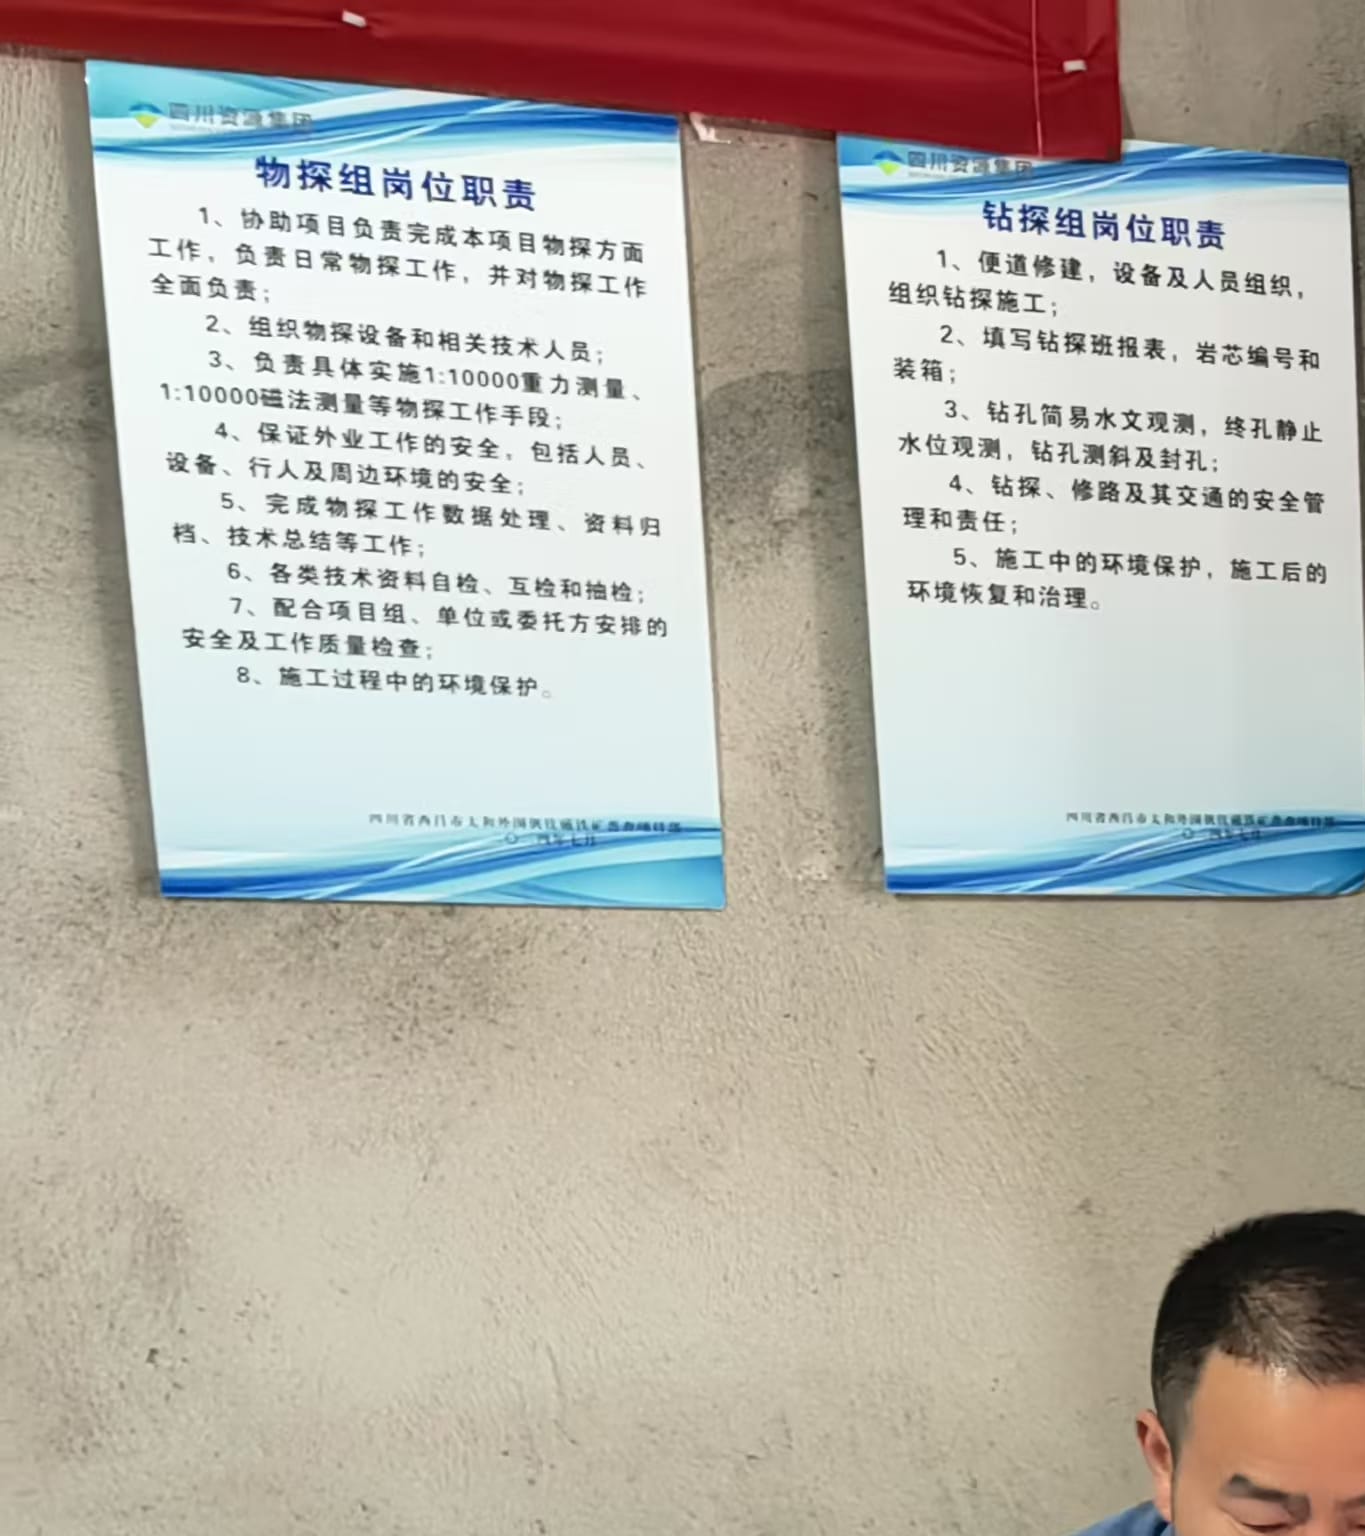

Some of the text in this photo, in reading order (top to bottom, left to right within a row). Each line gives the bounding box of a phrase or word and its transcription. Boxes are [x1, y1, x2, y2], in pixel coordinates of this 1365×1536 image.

[255, 155, 536, 211] 物探组岗位职责
[199, 207, 643, 263] 1、协助项目负责完成本项目物探方面
[982, 201, 1225, 250] 钻探组岗位职责
[151, 273, 269, 303] 全面负责；
[937, 250, 1303, 299] 1、便道修建，设备及人员组织，
[888, 281, 1056, 317] 组织钻探施工；
[206, 315, 602, 364] 2、组织物探设备和相关技术人员；
[940, 325, 1319, 371] 2、填写钻探班报表，岩芯编号和
[894, 357, 955, 384] 装箱；
[945, 400, 1323, 442] 3、钻孔简易水文观测，终孔静止
[898, 432, 1217, 472] 水位观测，钻孔测斜及封孔；
[166, 452, 523, 495] 设备、行人及周边环境的安全；
[949, 474, 1324, 514] 4、钻探、修路及其交通的安全管
[221, 492, 660, 537] 5、完成物探工作数据处理、资料归
[902, 507, 1016, 534] 理和责任；
[173, 523, 423, 557] 档、技术总结等工作；
[227, 562, 643, 603] 6、各类技术资料自检、互检和抽检；
[953, 547, 1327, 584] 5、施工中的环境保护，施工后的
[907, 580, 1098, 611] 环境恢复和治理。
[230, 597, 667, 637] 7、配合项目组、单位或委托方安排的
[182, 627, 431, 659] 安全及工作质量检查；
[237, 666, 552, 700] 8、施工过程中的环境保护。
